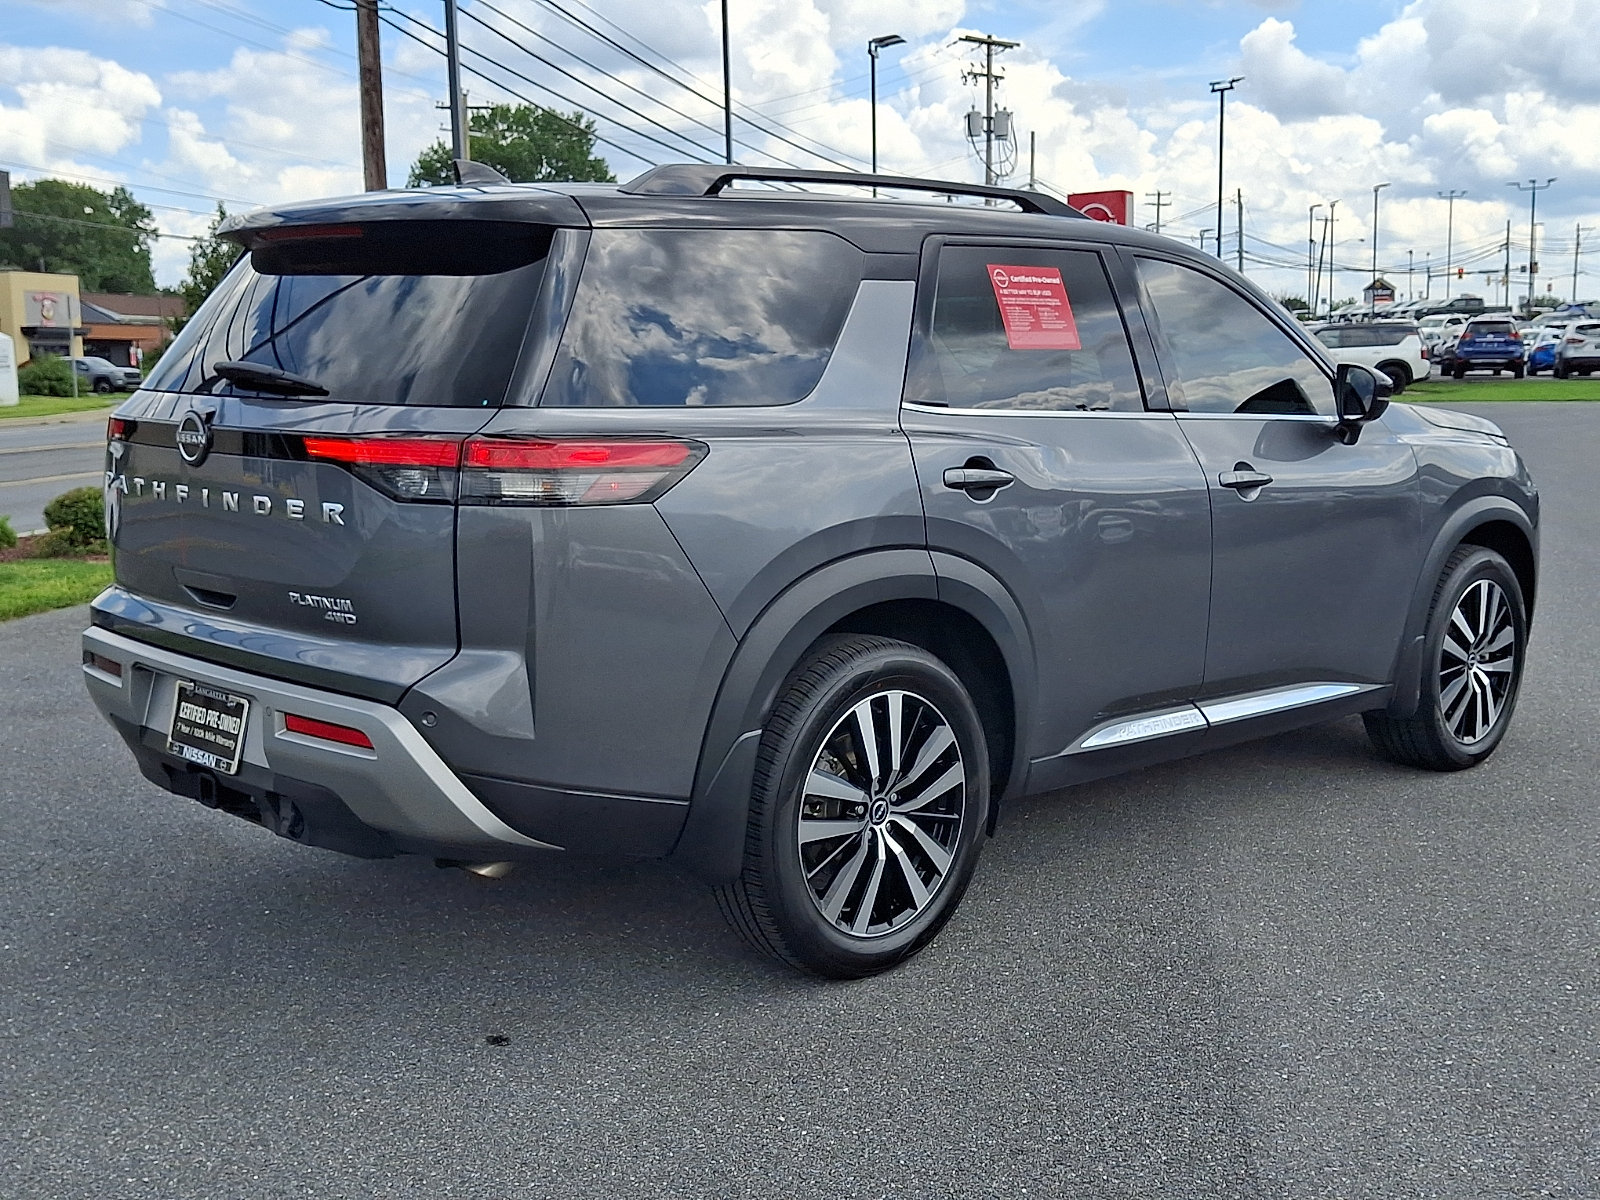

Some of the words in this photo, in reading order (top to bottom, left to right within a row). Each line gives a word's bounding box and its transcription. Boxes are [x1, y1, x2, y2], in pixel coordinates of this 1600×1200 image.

[1010, 275, 1032, 283] Certified
[1032, 276, 1060, 284] Pre-Owned
[106, 471, 345, 526] PATHFINDER
[288, 591, 354, 612] PLATINUM
[325, 611, 357, 625] 4WD
[195, 685, 228, 702] LANCASTER
[180, 701, 207, 725] CERTIFIED
[206, 709, 241, 735] PRE-OWNED
[1119, 711, 1200, 737] PATHFINDER
[181, 724, 191, 734] Year
[205, 730, 216, 742] Mile
[215, 734, 236, 751] Warranty
[183, 745, 217, 768] NISSAN
